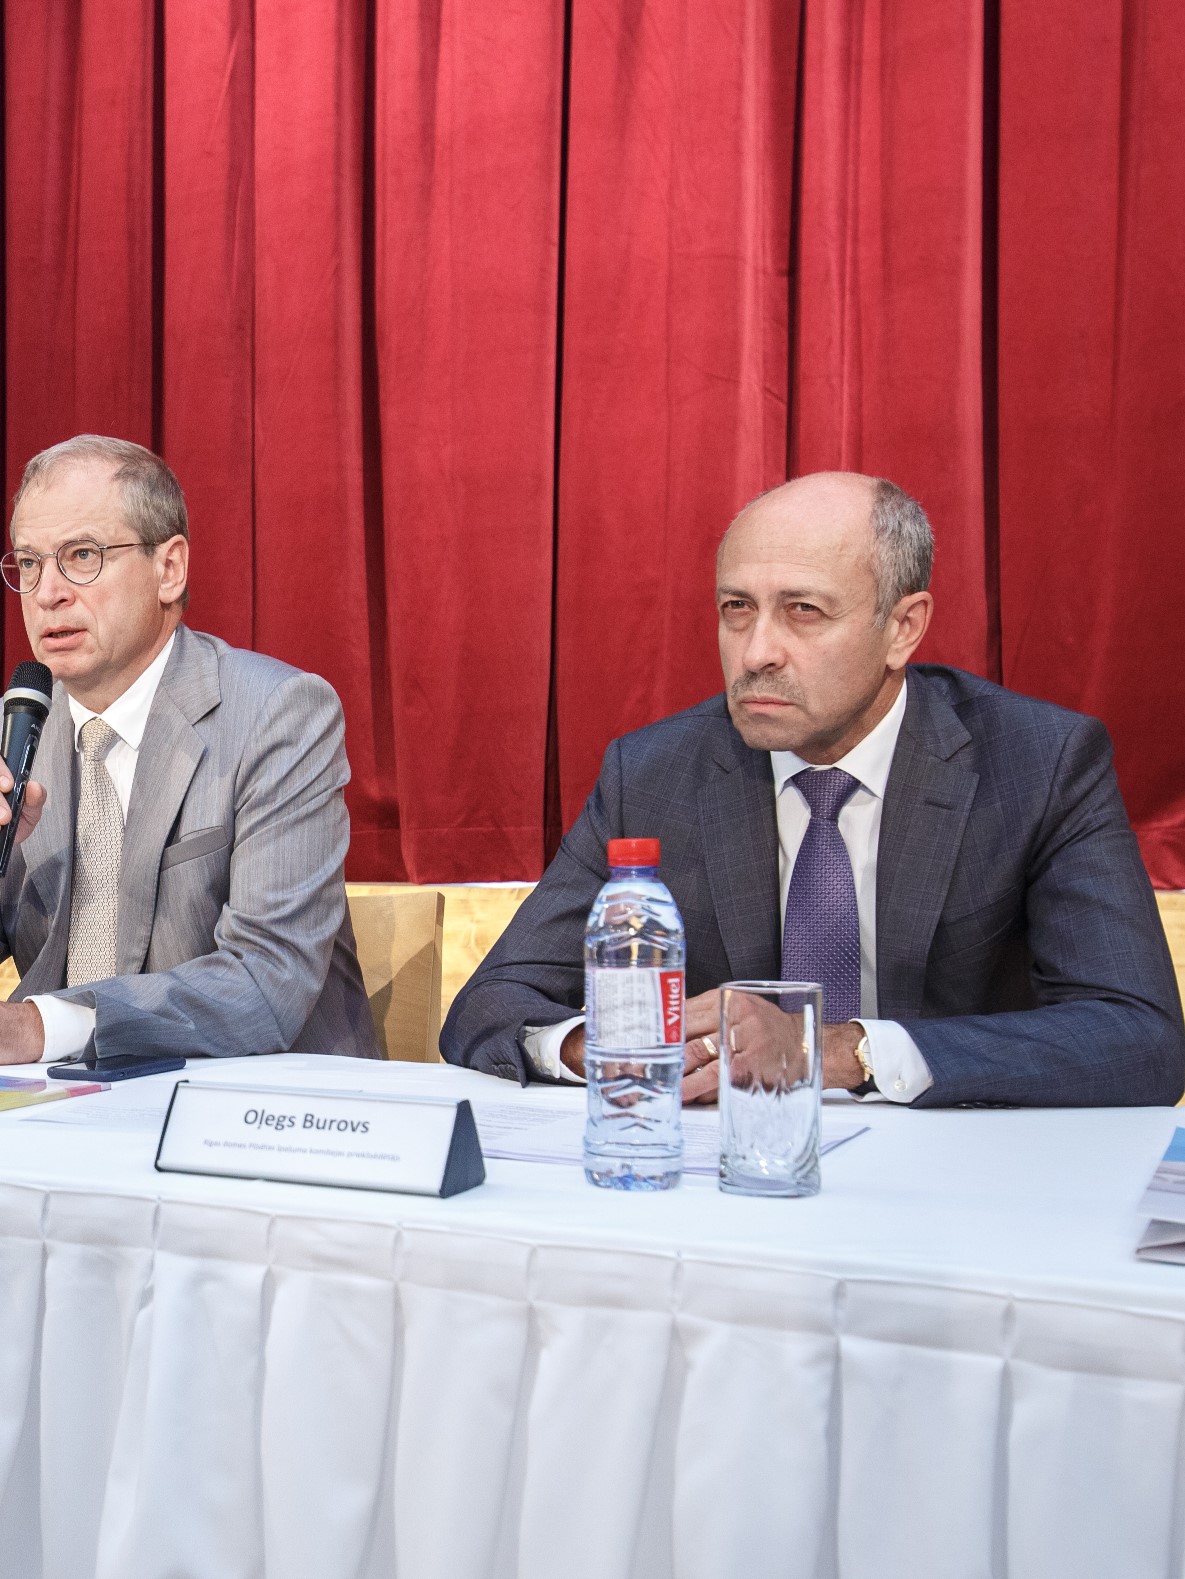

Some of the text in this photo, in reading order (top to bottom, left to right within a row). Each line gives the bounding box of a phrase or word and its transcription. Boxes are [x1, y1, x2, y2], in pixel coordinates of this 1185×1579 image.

[667, 977, 681, 1026] Vittel
[243, 1108, 370, 1134] Oļegs Burovs
